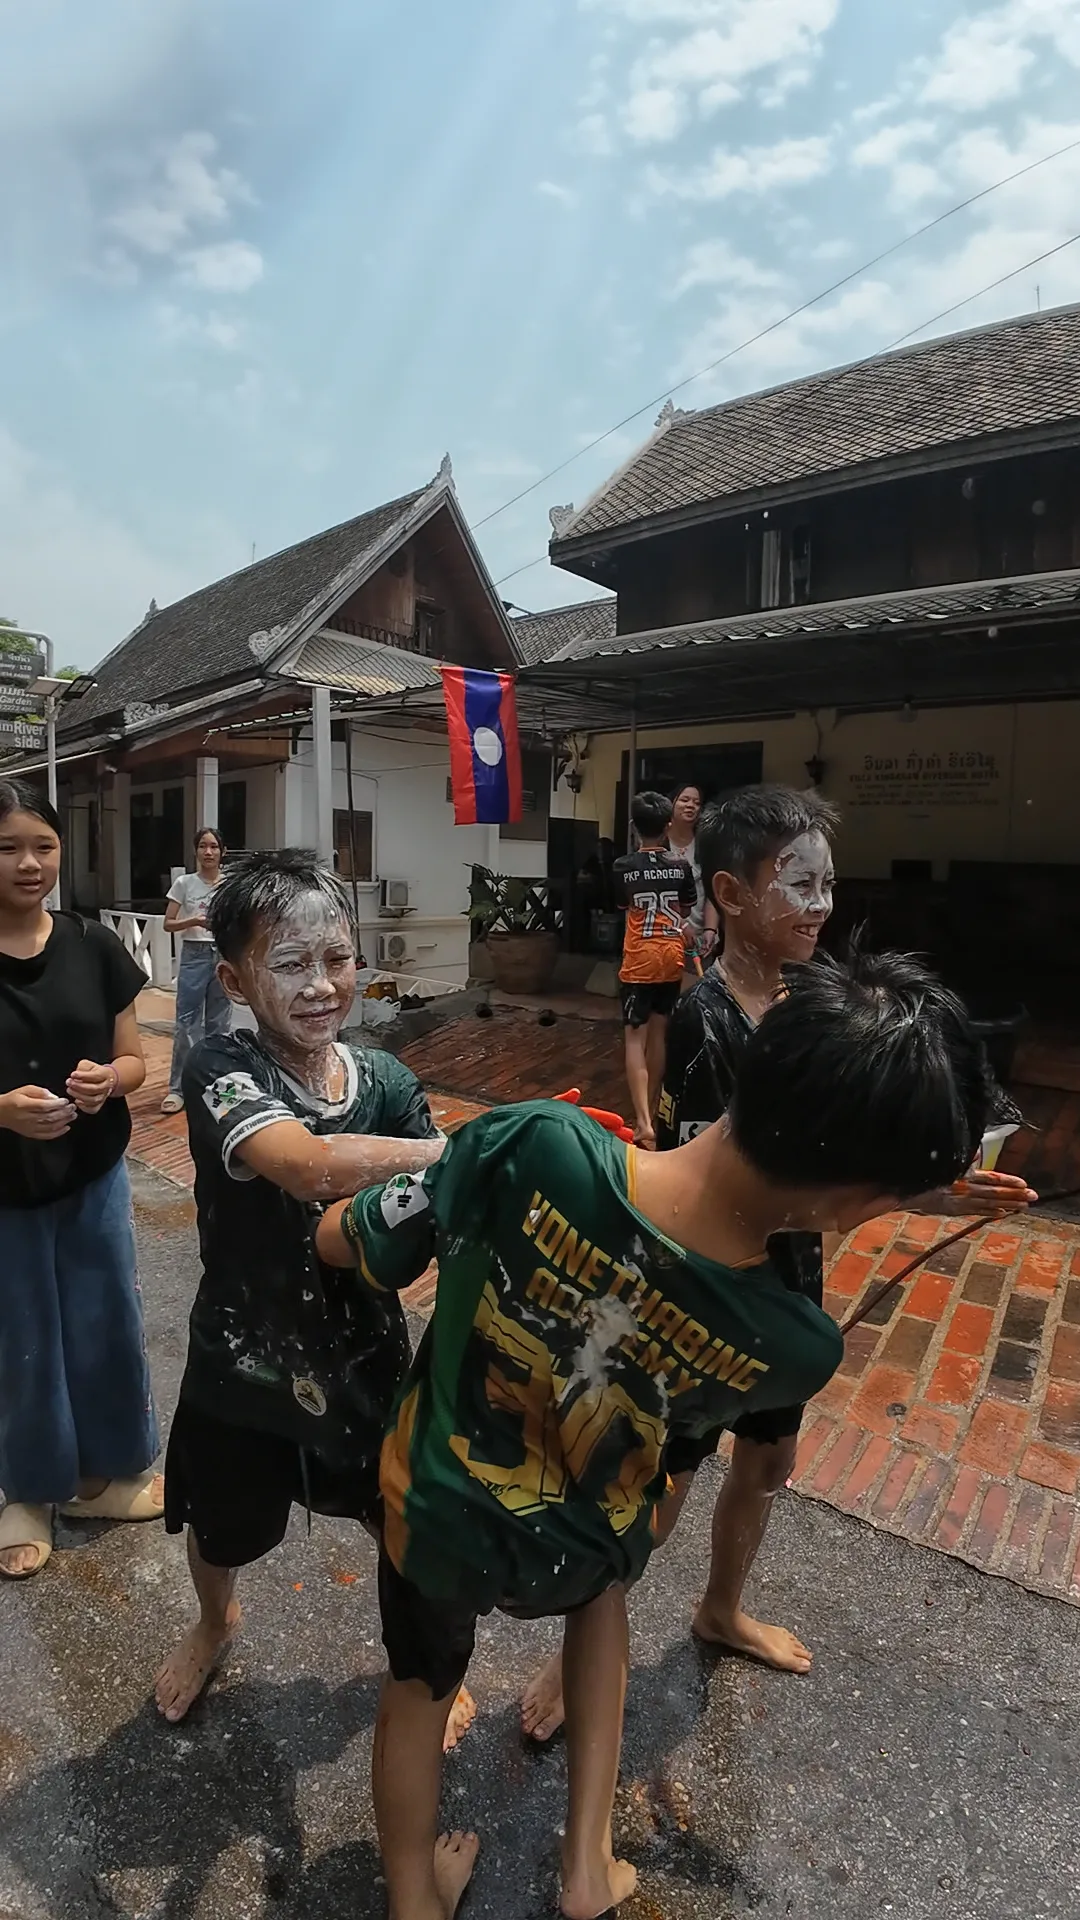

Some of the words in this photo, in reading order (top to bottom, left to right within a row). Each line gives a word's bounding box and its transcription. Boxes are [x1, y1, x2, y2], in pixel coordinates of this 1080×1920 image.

[0, 695, 32, 705] Garden
[14, 735, 41, 748] side
[623, 870, 640, 883] PKP
[633, 890, 682, 938] 75
